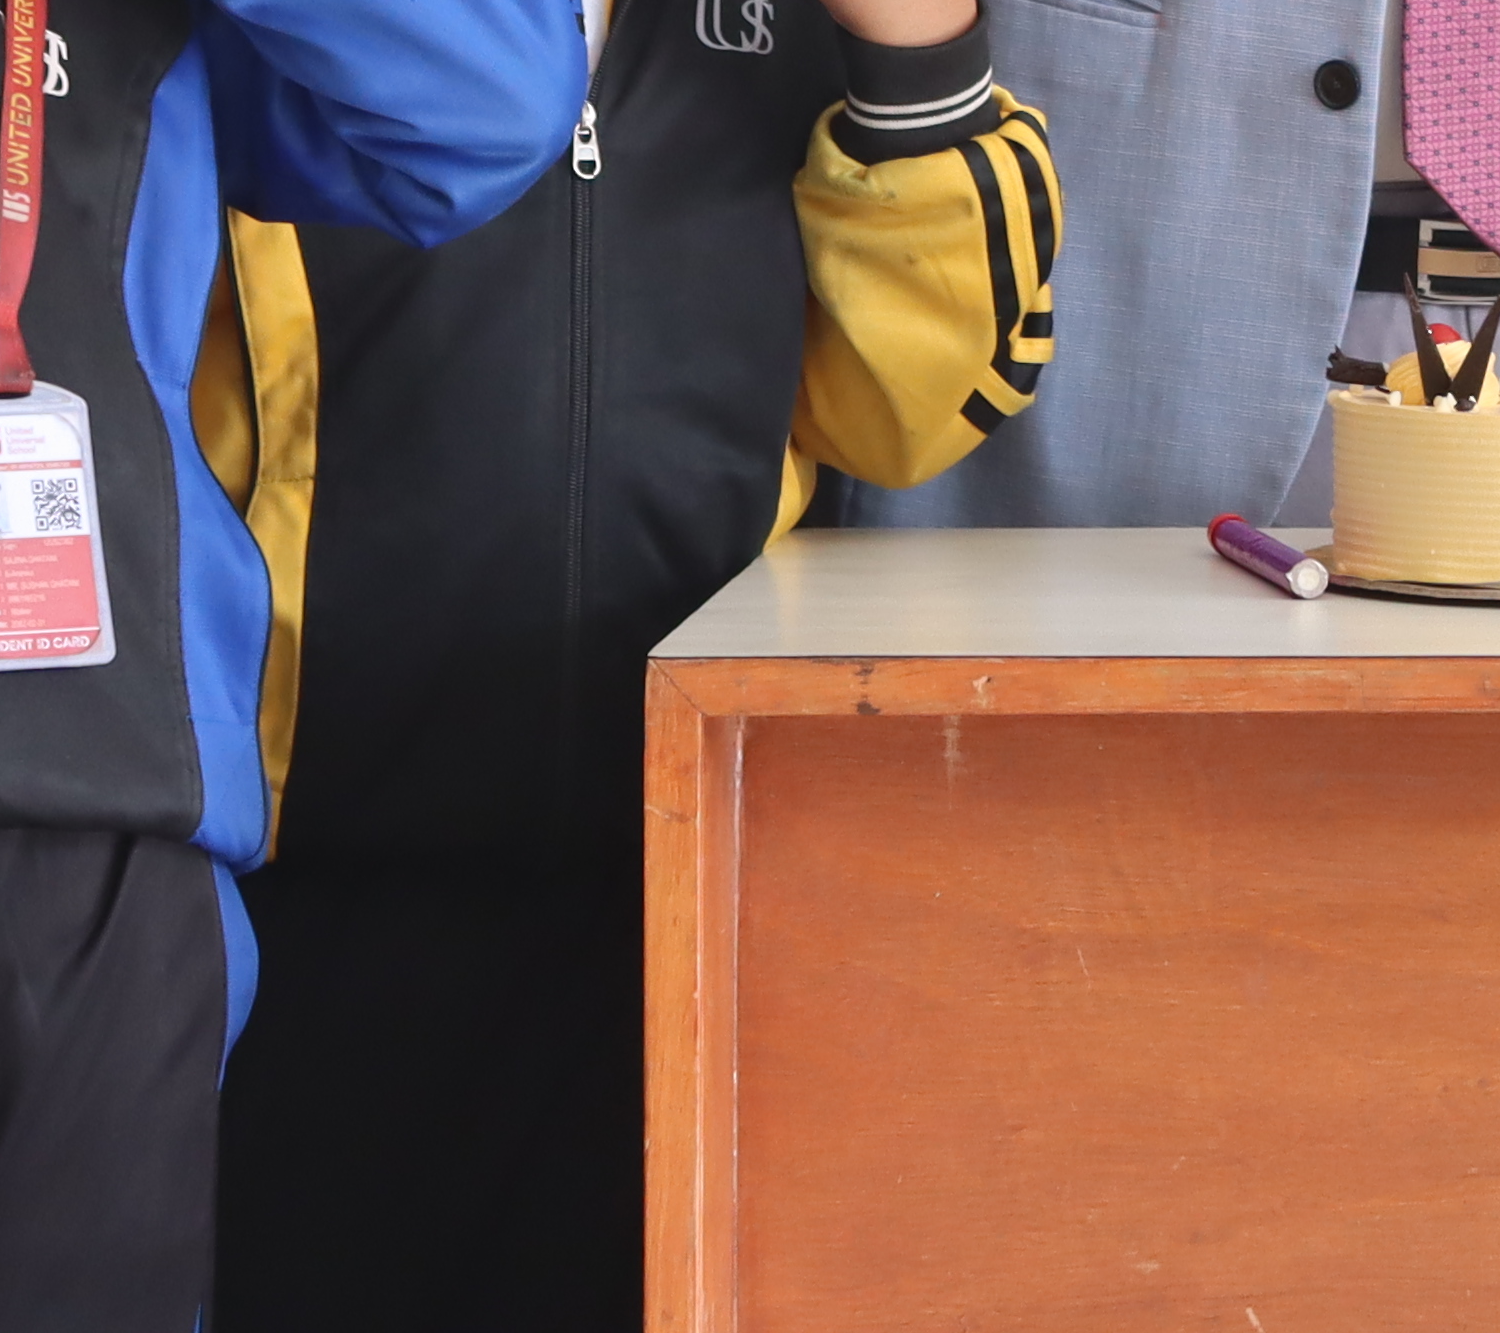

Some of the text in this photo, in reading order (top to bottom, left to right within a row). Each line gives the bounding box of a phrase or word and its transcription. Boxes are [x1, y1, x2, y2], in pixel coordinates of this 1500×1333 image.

[6, 92, 32, 186] UNITED
[37, 638, 51, 650] ID
[53, 635, 91, 649] CARD
